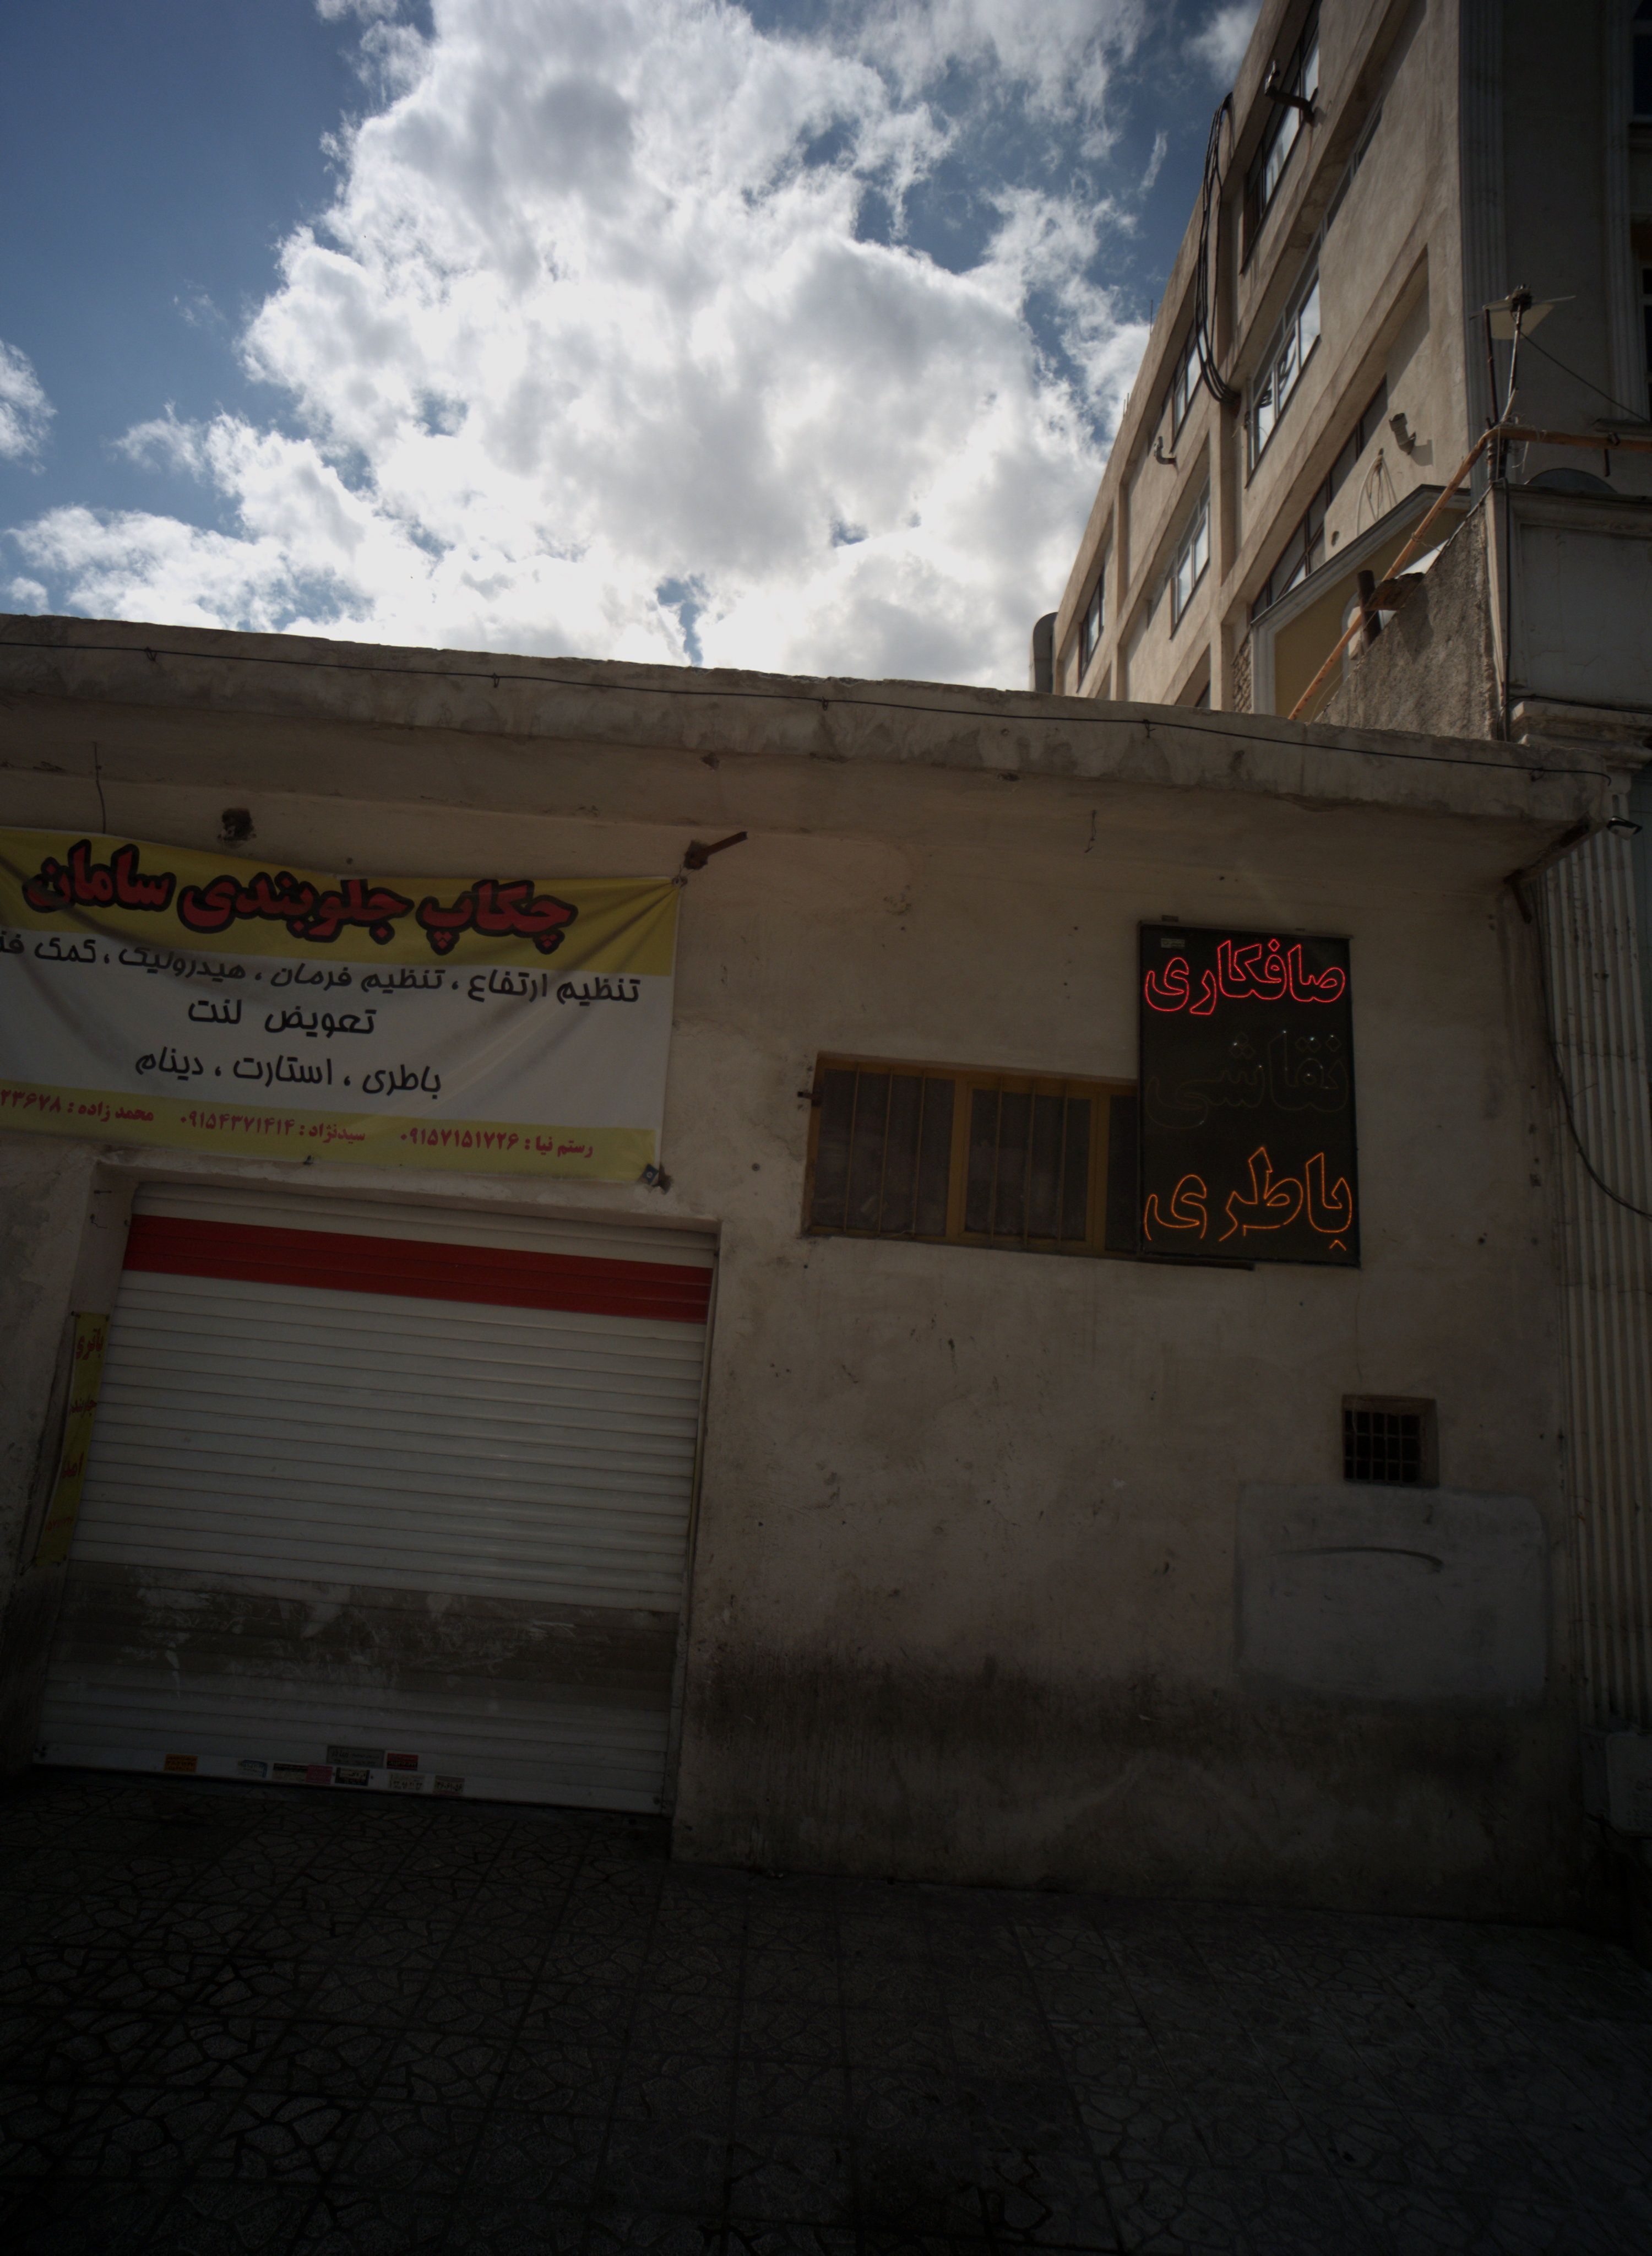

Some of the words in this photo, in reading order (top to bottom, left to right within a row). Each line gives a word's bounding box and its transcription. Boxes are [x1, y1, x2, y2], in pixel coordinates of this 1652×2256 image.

[23, 839, 176, 913] سامان
[177, 871, 414, 945] جلوبندی
[416, 880, 578, 955] چکاپ
[35, 937, 96, 963] کمک
[118, 946, 246, 983] هیدرولیک
[270, 962, 352, 991] فرمان
[361, 968, 445, 993] تنظیم
[468, 970, 547, 1002] ارتفاع
[557, 977, 640, 1006] تنظیم
[1145, 937, 1346, 1015] صافکاری
[188, 999, 241, 1024] لنت
[265, 1006, 377, 1038] تعویض
[135, 1047, 204, 1080] دینام
[233, 1055, 332, 1087] استارت
[362, 1065, 441, 1099] باطری
[78, 1102, 111, 1122] زاده
[115, 1107, 154, 1122] محمد
[535, 1135, 553, 1155] نیا
[557, 1140, 593, 1158] رستم
[1144, 1146, 1353, 1251] باطری
